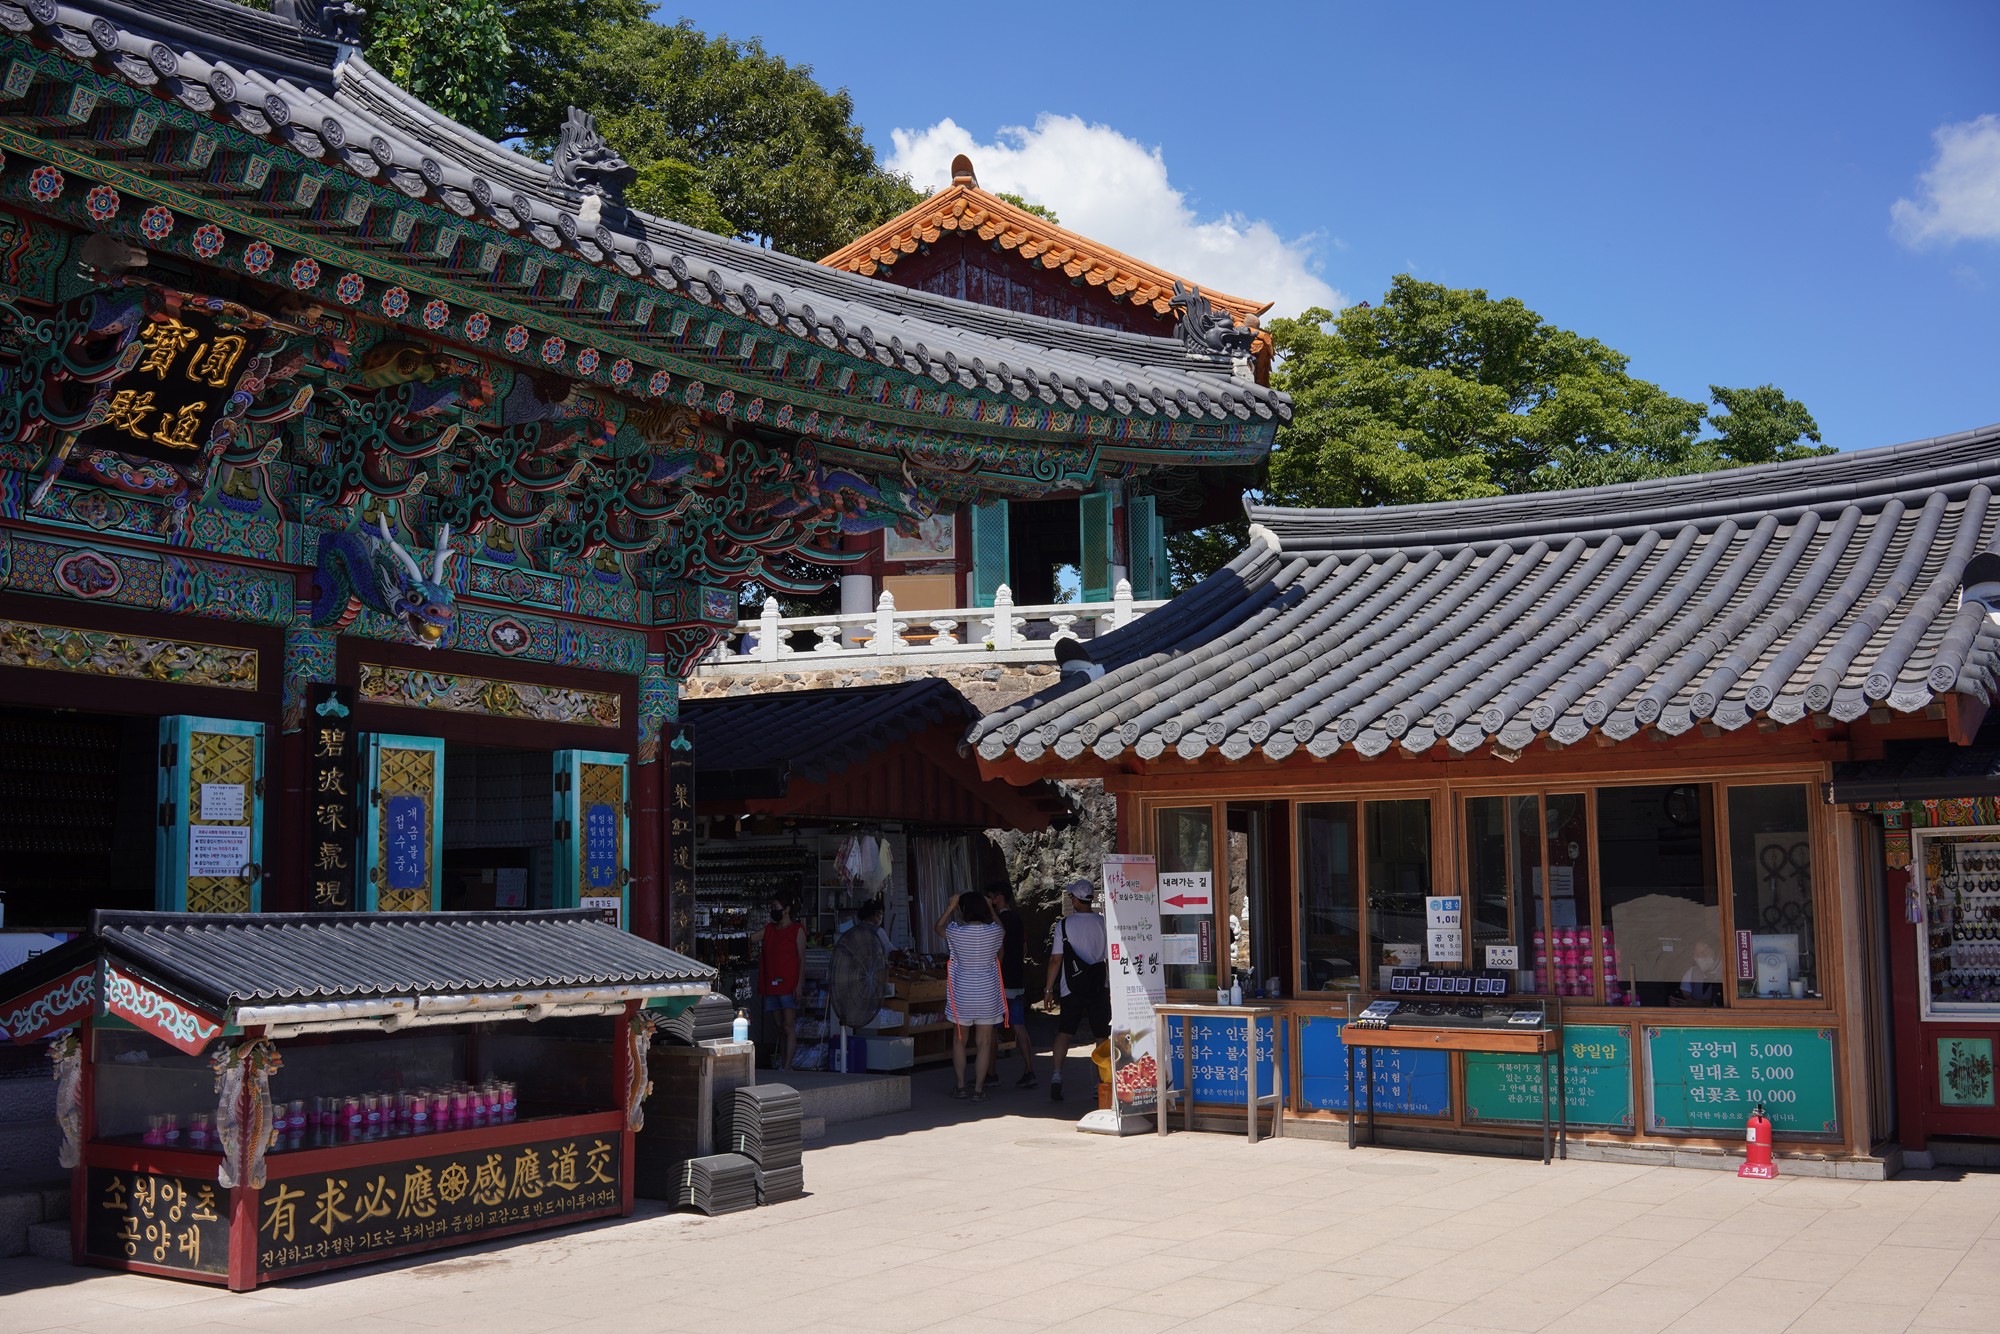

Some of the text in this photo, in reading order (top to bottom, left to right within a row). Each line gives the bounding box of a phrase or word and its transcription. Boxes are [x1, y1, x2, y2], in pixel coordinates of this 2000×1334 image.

[394, 815, 406, 872] 접수중
[407, 807, 419, 877] 개금불사
[591, 866, 614, 879] 접수
[1163, 877, 1207, 888] 내려가는 길
[1168, 1025, 1212, 1041] 도접수
[1170, 1045, 1213, 1060] 등접수
[1572, 1043, 1617, 1060] 향일암
[1688, 1041, 1793, 1060] 공양미 5,000
[1192, 1066, 1248, 1082] 공양물접수
[1497, 1063, 1530, 1072] 거북이가
[1534, 1064, 1558, 1074] 경을
[1689, 1064, 1794, 1082] 밀대초 5,000
[1506, 1074, 1521, 1082] 있는
[1550, 1086, 1574, 1094] 머고
[1578, 1087, 1596, 1096] 있는
[1690, 1086, 1796, 1105] 연꽃초 10,000
[1508, 1094, 1556, 1105] 관음기도량
[1689, 1112, 1711, 1120] 지극한
[1714, 1112, 1743, 1120] 마음으로
[103, 1176, 218, 1222] 소원양초
[359, 1230, 396, 1249] 기도는
[400, 1219, 448, 1241] 부처님과
[450, 1212, 484, 1232] 중생의
[487, 1203, 531, 1225] 교감으로
[117, 1216, 200, 1267] 공양대
